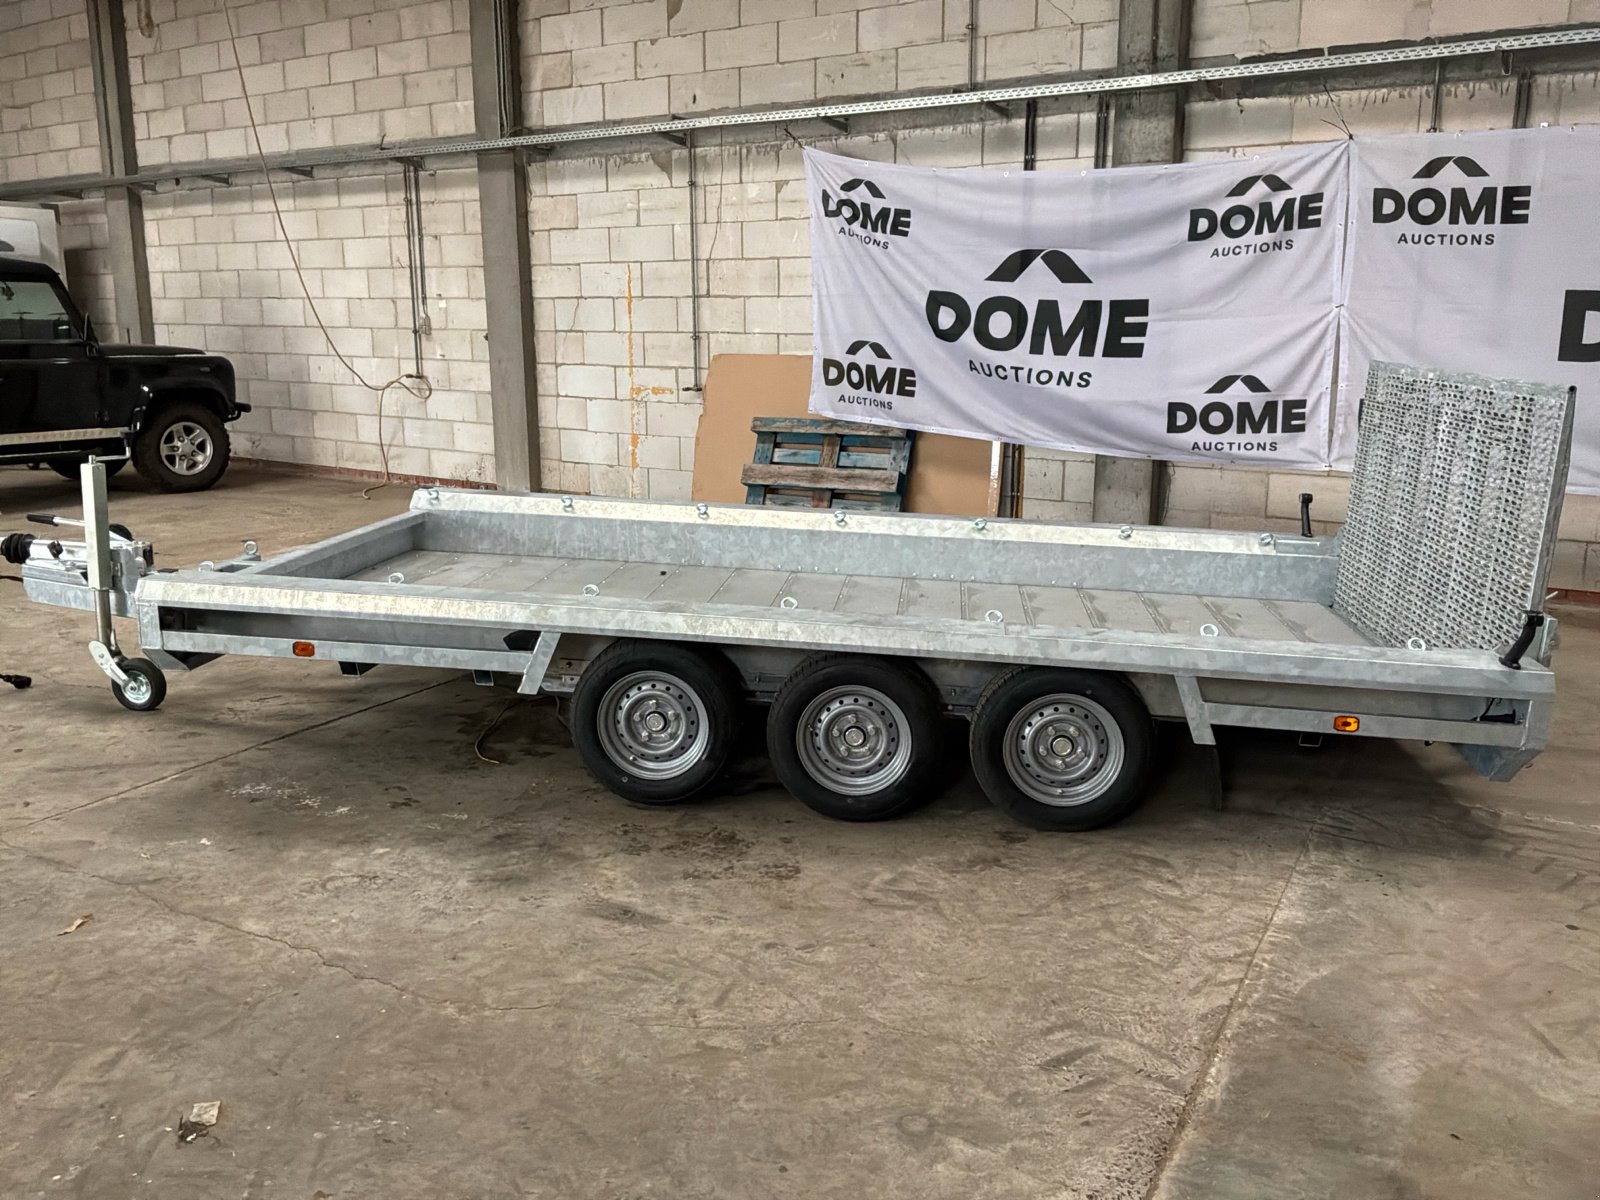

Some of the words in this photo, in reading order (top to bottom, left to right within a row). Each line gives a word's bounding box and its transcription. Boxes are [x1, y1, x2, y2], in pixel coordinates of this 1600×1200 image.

[821, 189, 911, 237] DOME
[1188, 192, 1324, 242] DOME
[1373, 186, 1532, 225] DOME
[1210, 239, 1294, 258] AUCTIONS
[1398, 233, 1495, 246] AUCTIONS
[926, 290, 1149, 358] DOME
[823, 358, 916, 398] DOME
[969, 359, 1092, 388] AUCTIONS
[838, 394, 893, 410] AUCTIONS
[1167, 399, 1307, 434] DOME
[1191, 441, 1277, 452] AUCTIONS
